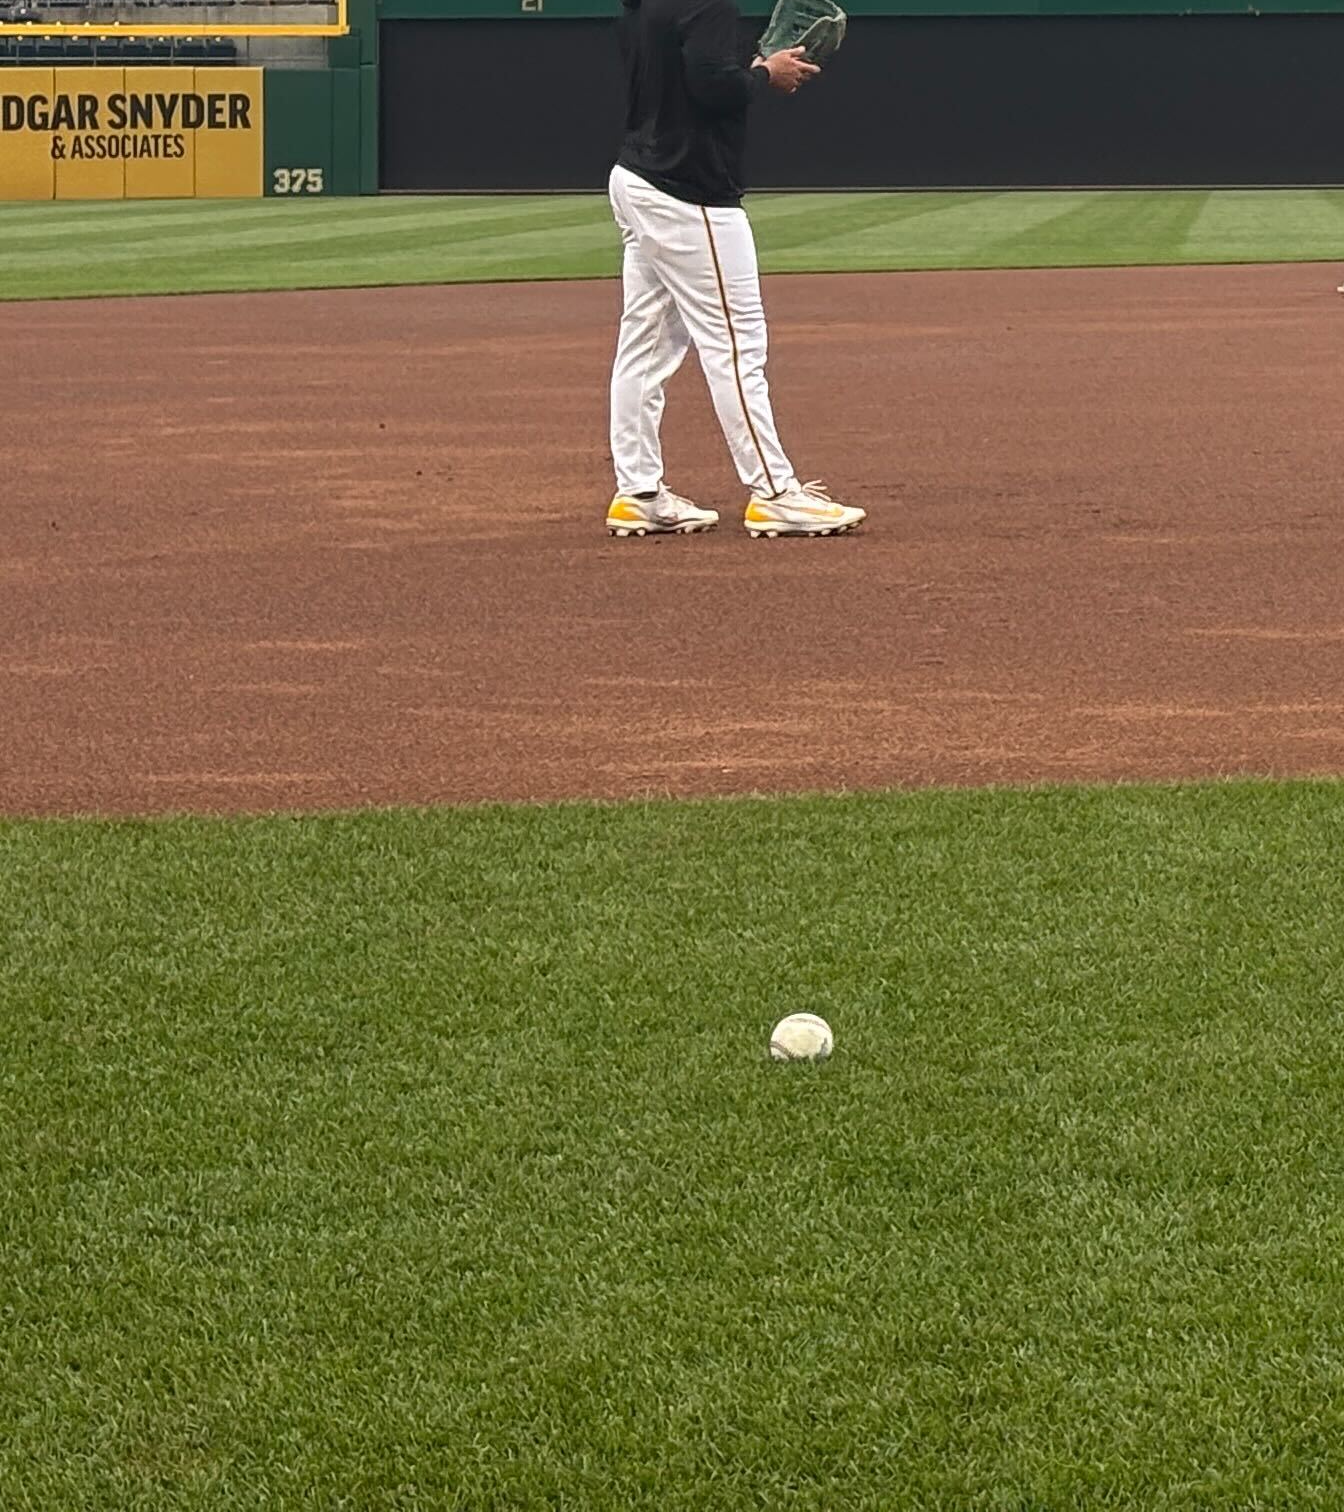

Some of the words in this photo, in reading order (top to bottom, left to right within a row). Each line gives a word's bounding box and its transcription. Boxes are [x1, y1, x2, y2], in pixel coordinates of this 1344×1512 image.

[107, 93, 251, 130] SNYDER
[51, 135, 66, 159] &
[71, 134, 185, 159] ASSOCIATES
[273, 168, 323, 193] 375
